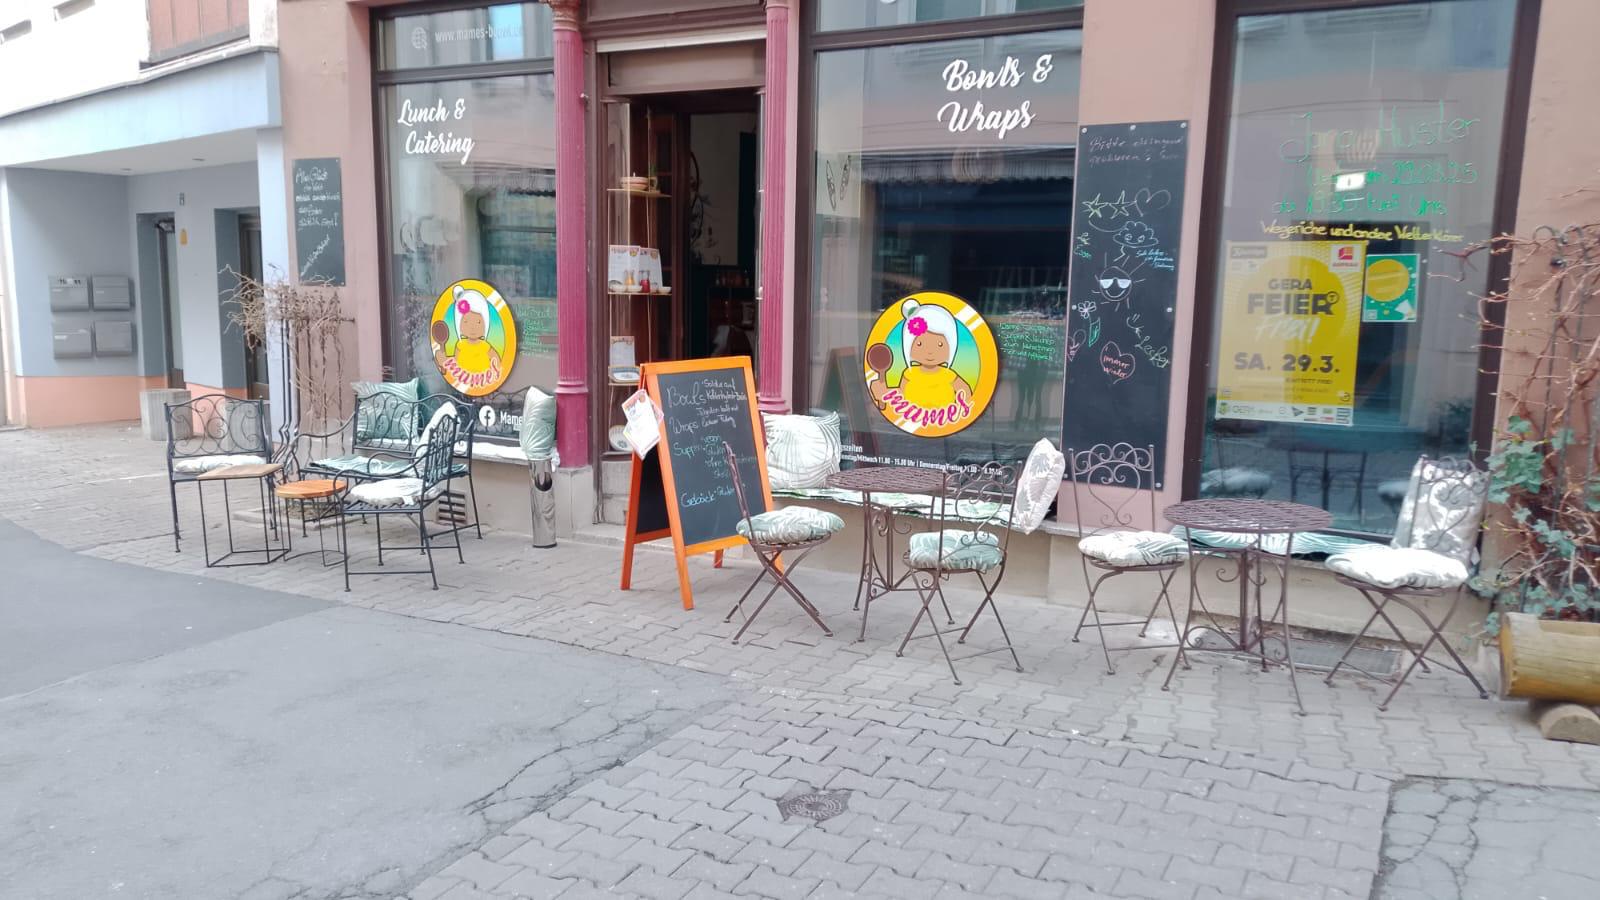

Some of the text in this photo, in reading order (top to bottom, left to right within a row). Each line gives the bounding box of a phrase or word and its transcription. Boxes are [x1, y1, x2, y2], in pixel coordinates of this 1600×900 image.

[942, 54, 1053, 92] Bowls &
[398, 98, 466, 126] Lunch &
[937, 100, 1036, 139] Wraps
[405, 130, 475, 165] Catering
[1268, 278, 1313, 291] GERA
[1248, 293, 1334, 316] FEIER
[444, 357, 501, 388] mames
[1234, 352, 1340, 374] SA. 29.3.
[500, 411, 523, 425] Mame
[882, 390, 975, 428] mames
